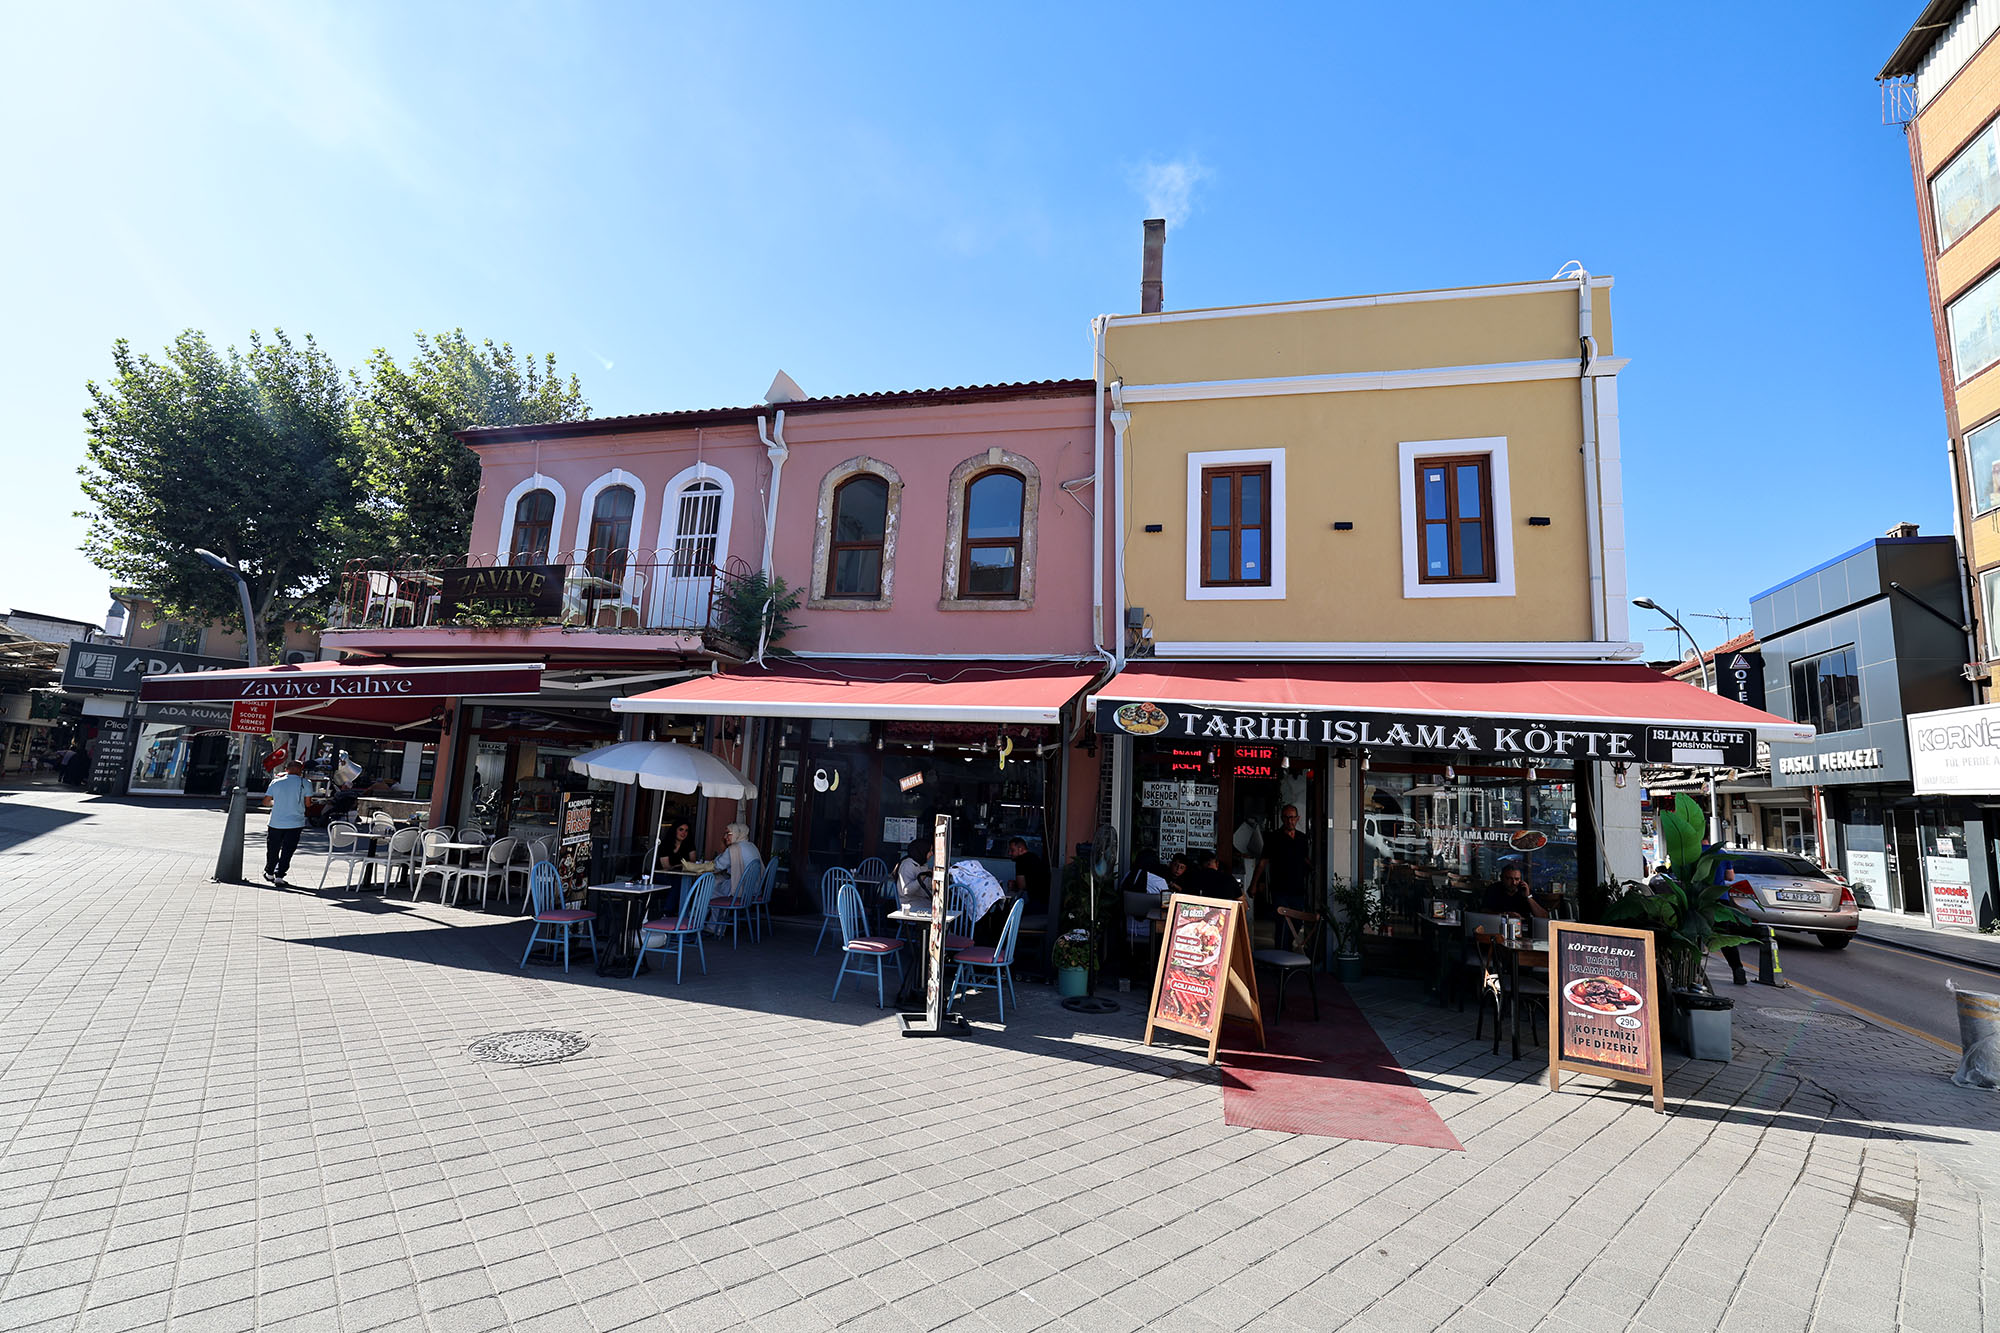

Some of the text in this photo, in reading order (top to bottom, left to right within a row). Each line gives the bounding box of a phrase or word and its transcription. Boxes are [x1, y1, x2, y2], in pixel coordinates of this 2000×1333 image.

[240, 676, 413, 698] Zaviye Kahve
[1735, 669, 1749, 704] OTE
[159, 707, 187, 716] ADA
[1179, 711, 1636, 758] TARİHİ ISLAMA KÖFTE
[1653, 729, 1744, 744] ISLAMA KÖFTE
[1672, 741, 1712, 750] PORSİYON
[1779, 755, 1815, 773] BASKI
[1144, 788, 1178, 800] İSKENDER
[1162, 816, 1185, 824] ADANA
[1484, 831, 1509, 841] KÖFTE
[1934, 886, 1968, 899] KORNİŞ
[1568, 943, 1636, 957] KÖFTECİ EROL
[1586, 955, 1619, 967] TARİHİ
[1607, 968, 1638, 980] KÖFTE
[1620, 1017, 1635, 1026] 290
[1575, 1023, 1636, 1042] KÖFTEMİZİ
[1594, 1038, 1639, 1055] DİZERİZ
